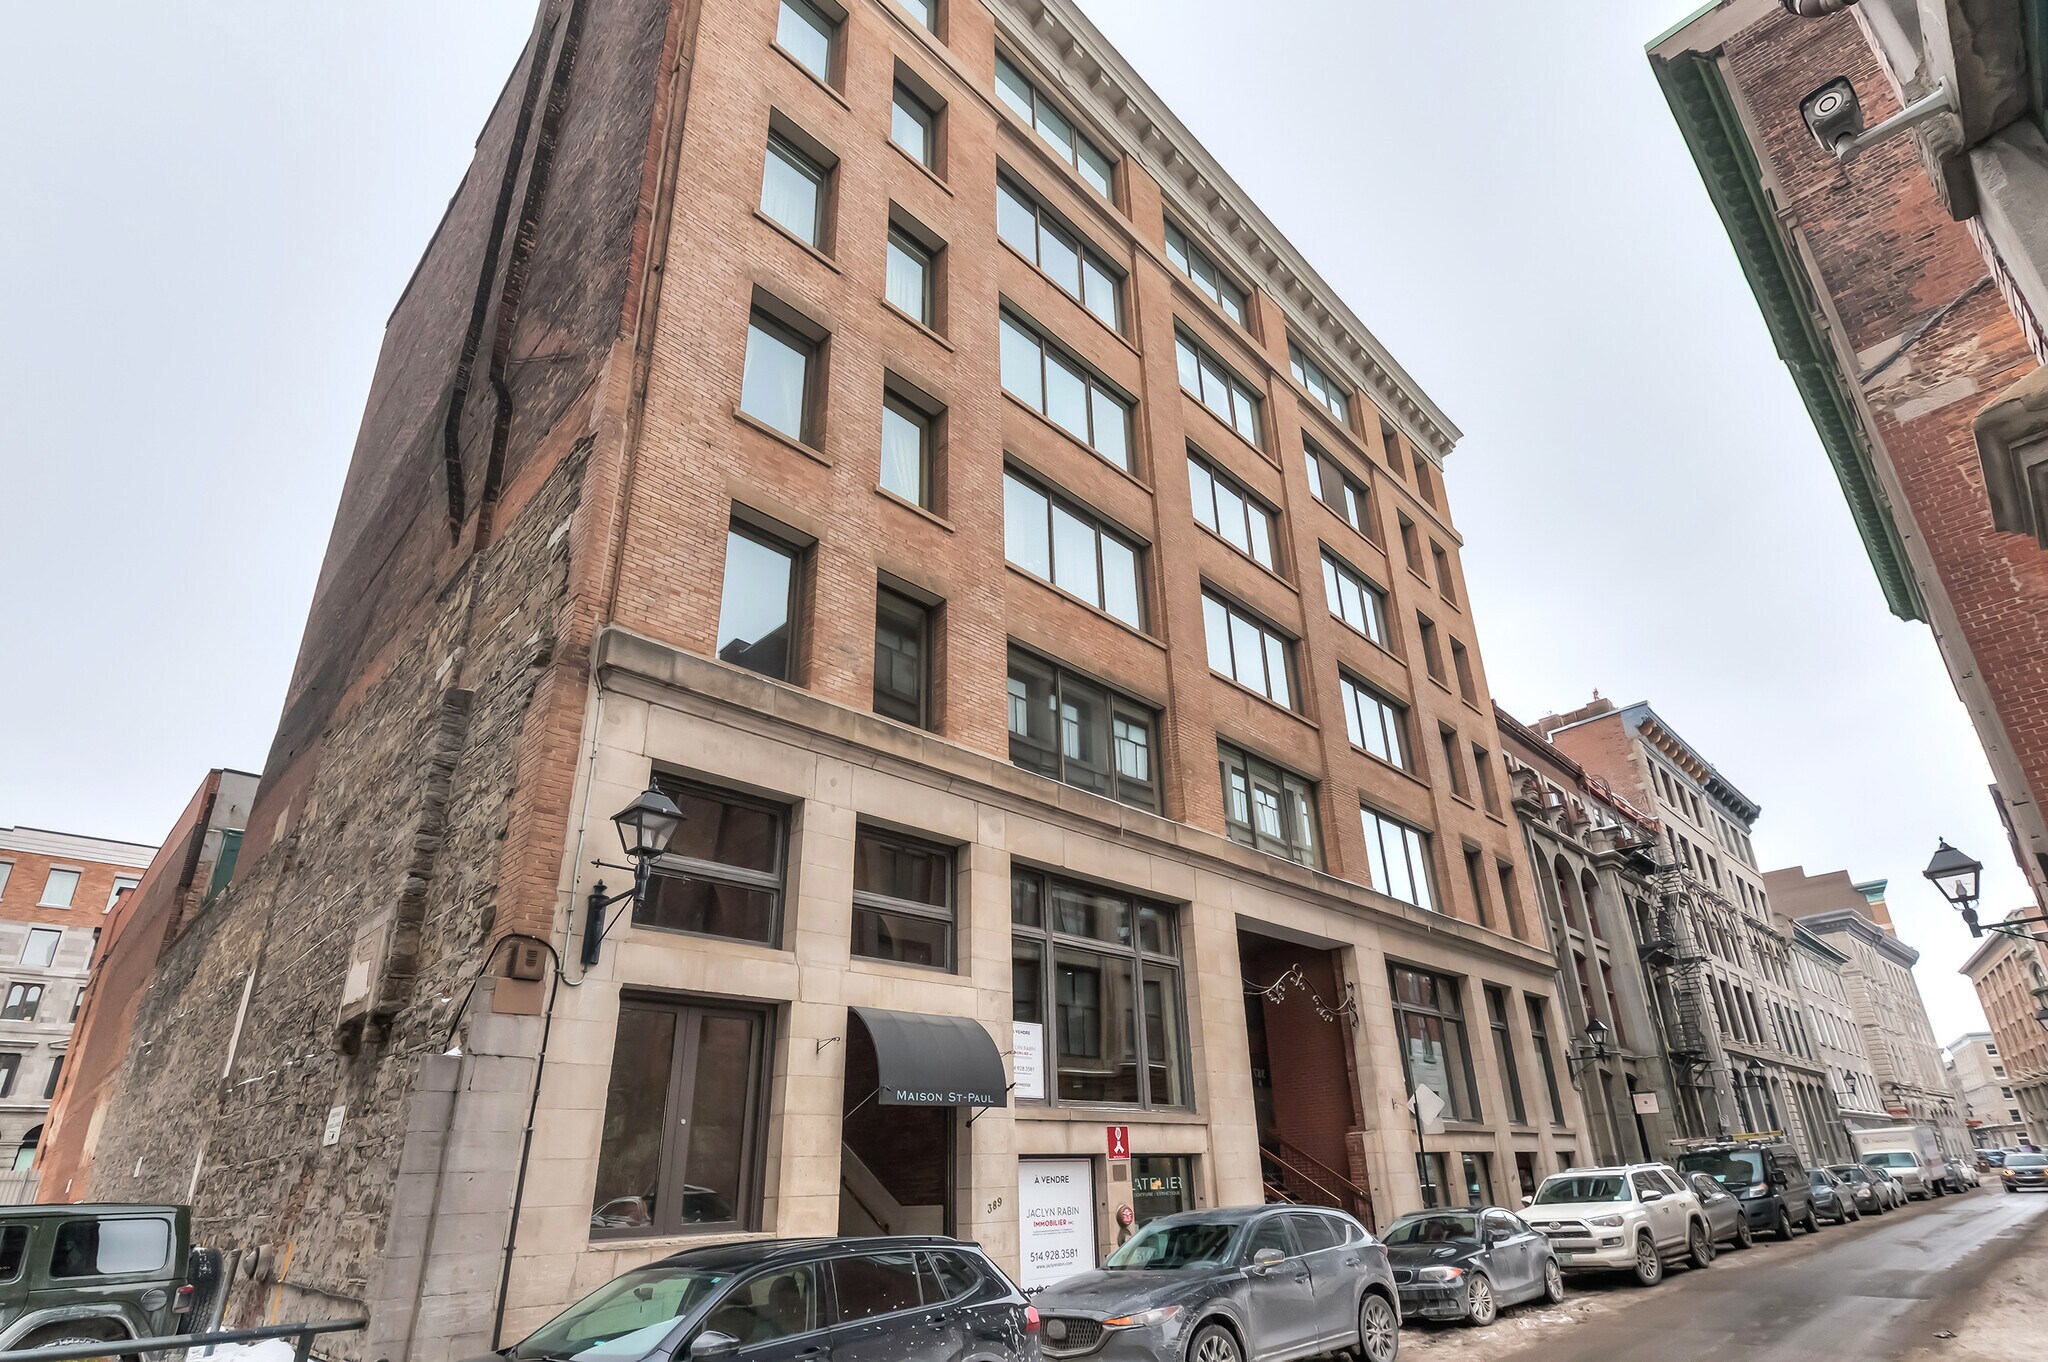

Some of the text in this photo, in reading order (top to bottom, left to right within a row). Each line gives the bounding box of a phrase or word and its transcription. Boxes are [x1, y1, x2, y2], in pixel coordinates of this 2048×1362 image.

[896, 1090, 994, 1103] MAISON ST-PAUL
[1034, 1174, 1070, 1184] À VENDRE
[1132, 1176, 1182, 1190] 'ATELIER
[987, 1197, 1003, 1214] 389
[1026, 1206, 1080, 1219] JACLYN RABIN
[1033, 1219, 1067, 1227] IMMOBILIER
[1030, 1248, 1078, 1262] 514.928.3581
